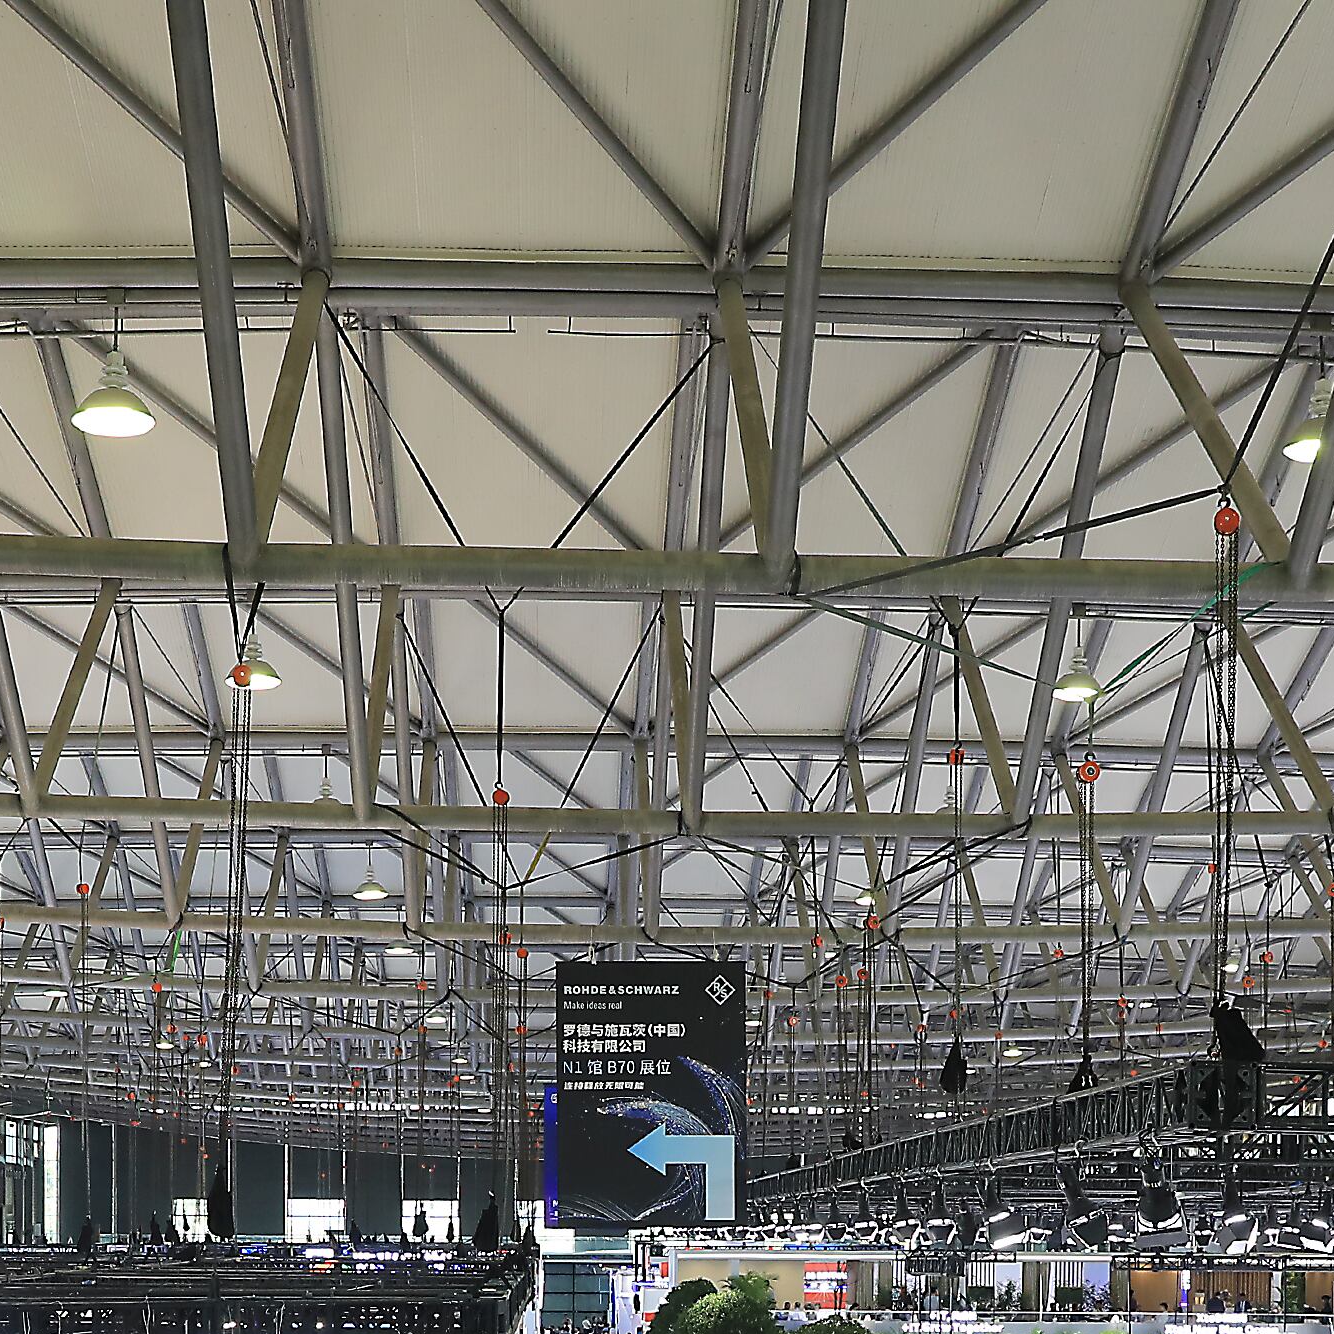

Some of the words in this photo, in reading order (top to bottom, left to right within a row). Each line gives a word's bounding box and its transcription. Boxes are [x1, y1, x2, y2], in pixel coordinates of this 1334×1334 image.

[563, 1001, 584, 1010] Make
[586, 1001, 606, 1010] ideas
[608, 1001, 622, 1010] real
[562, 1039, 646, 1053] 科技有限公司
[563, 1060, 582, 1074] N1
[587, 1059, 603, 1075] 馆
[608, 1060, 635, 1074] B70
[639, 1059, 671, 1075] 展位
